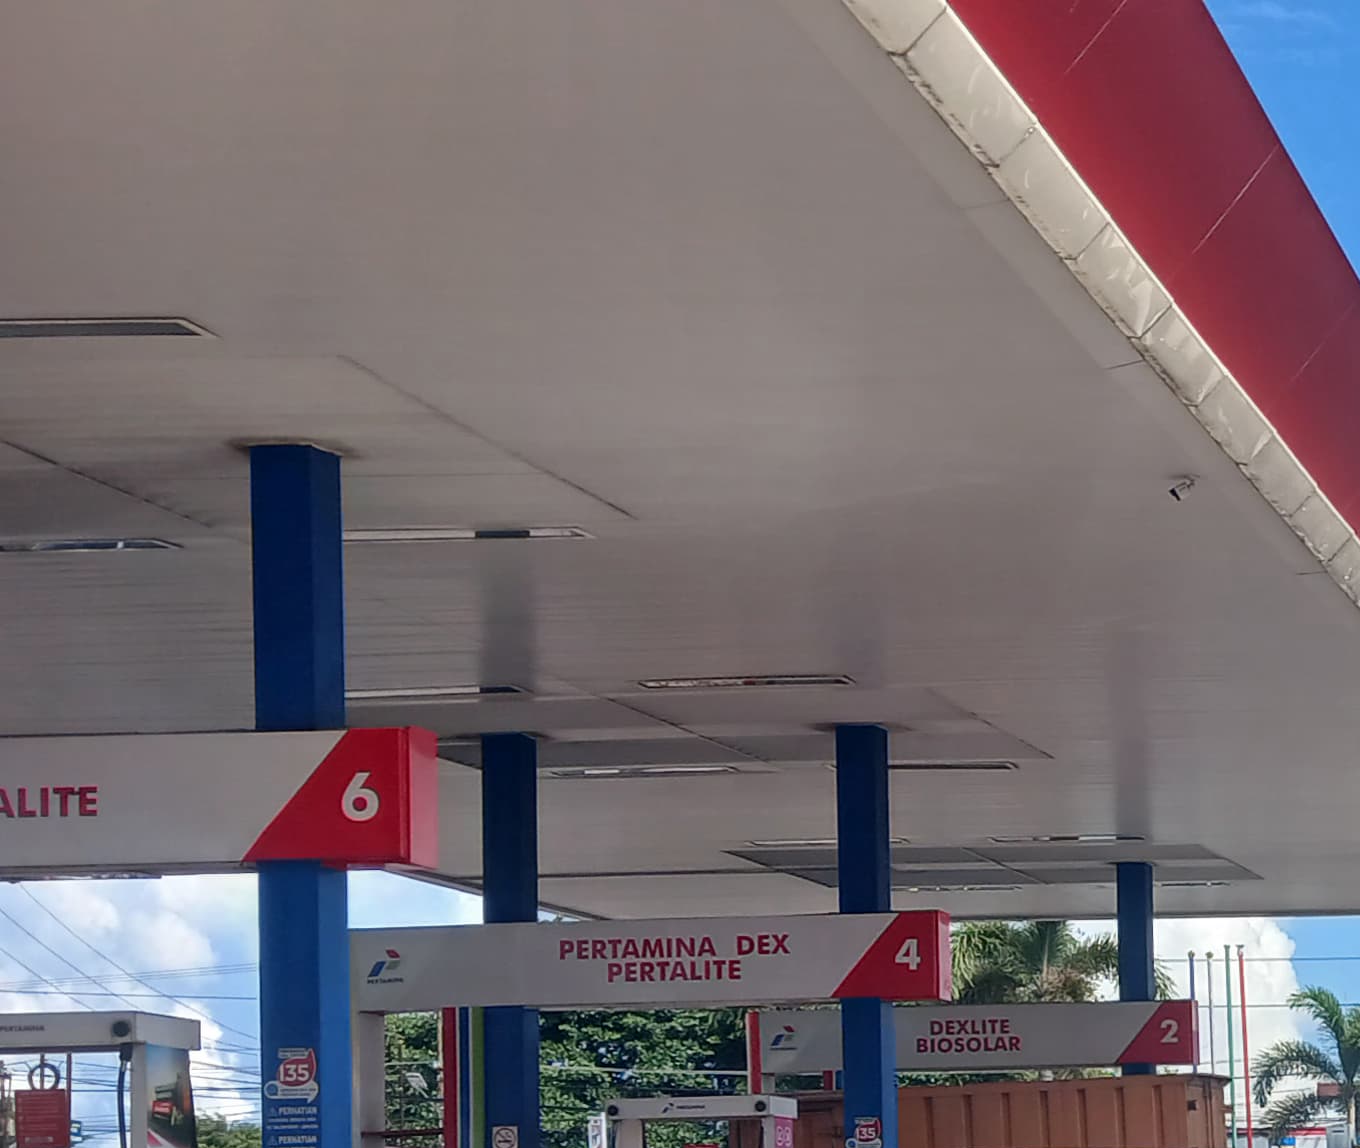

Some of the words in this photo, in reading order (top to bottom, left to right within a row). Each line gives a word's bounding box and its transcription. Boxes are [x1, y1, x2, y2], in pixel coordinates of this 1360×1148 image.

[0, 786, 98, 818] ALITE
[340, 772, 380, 822] 6
[559, 936, 717, 961] PERTAMINA
[736, 933, 790, 957] DEX
[895, 938, 921, 971] 4
[606, 959, 742, 983] PERTALITE
[929, 1019, 1010, 1035] DEXLITE
[1159, 1019, 1179, 1043] 2
[915, 1035, 1021, 1054] BIOSOLAR
[280, 1063, 310, 1082] 135
